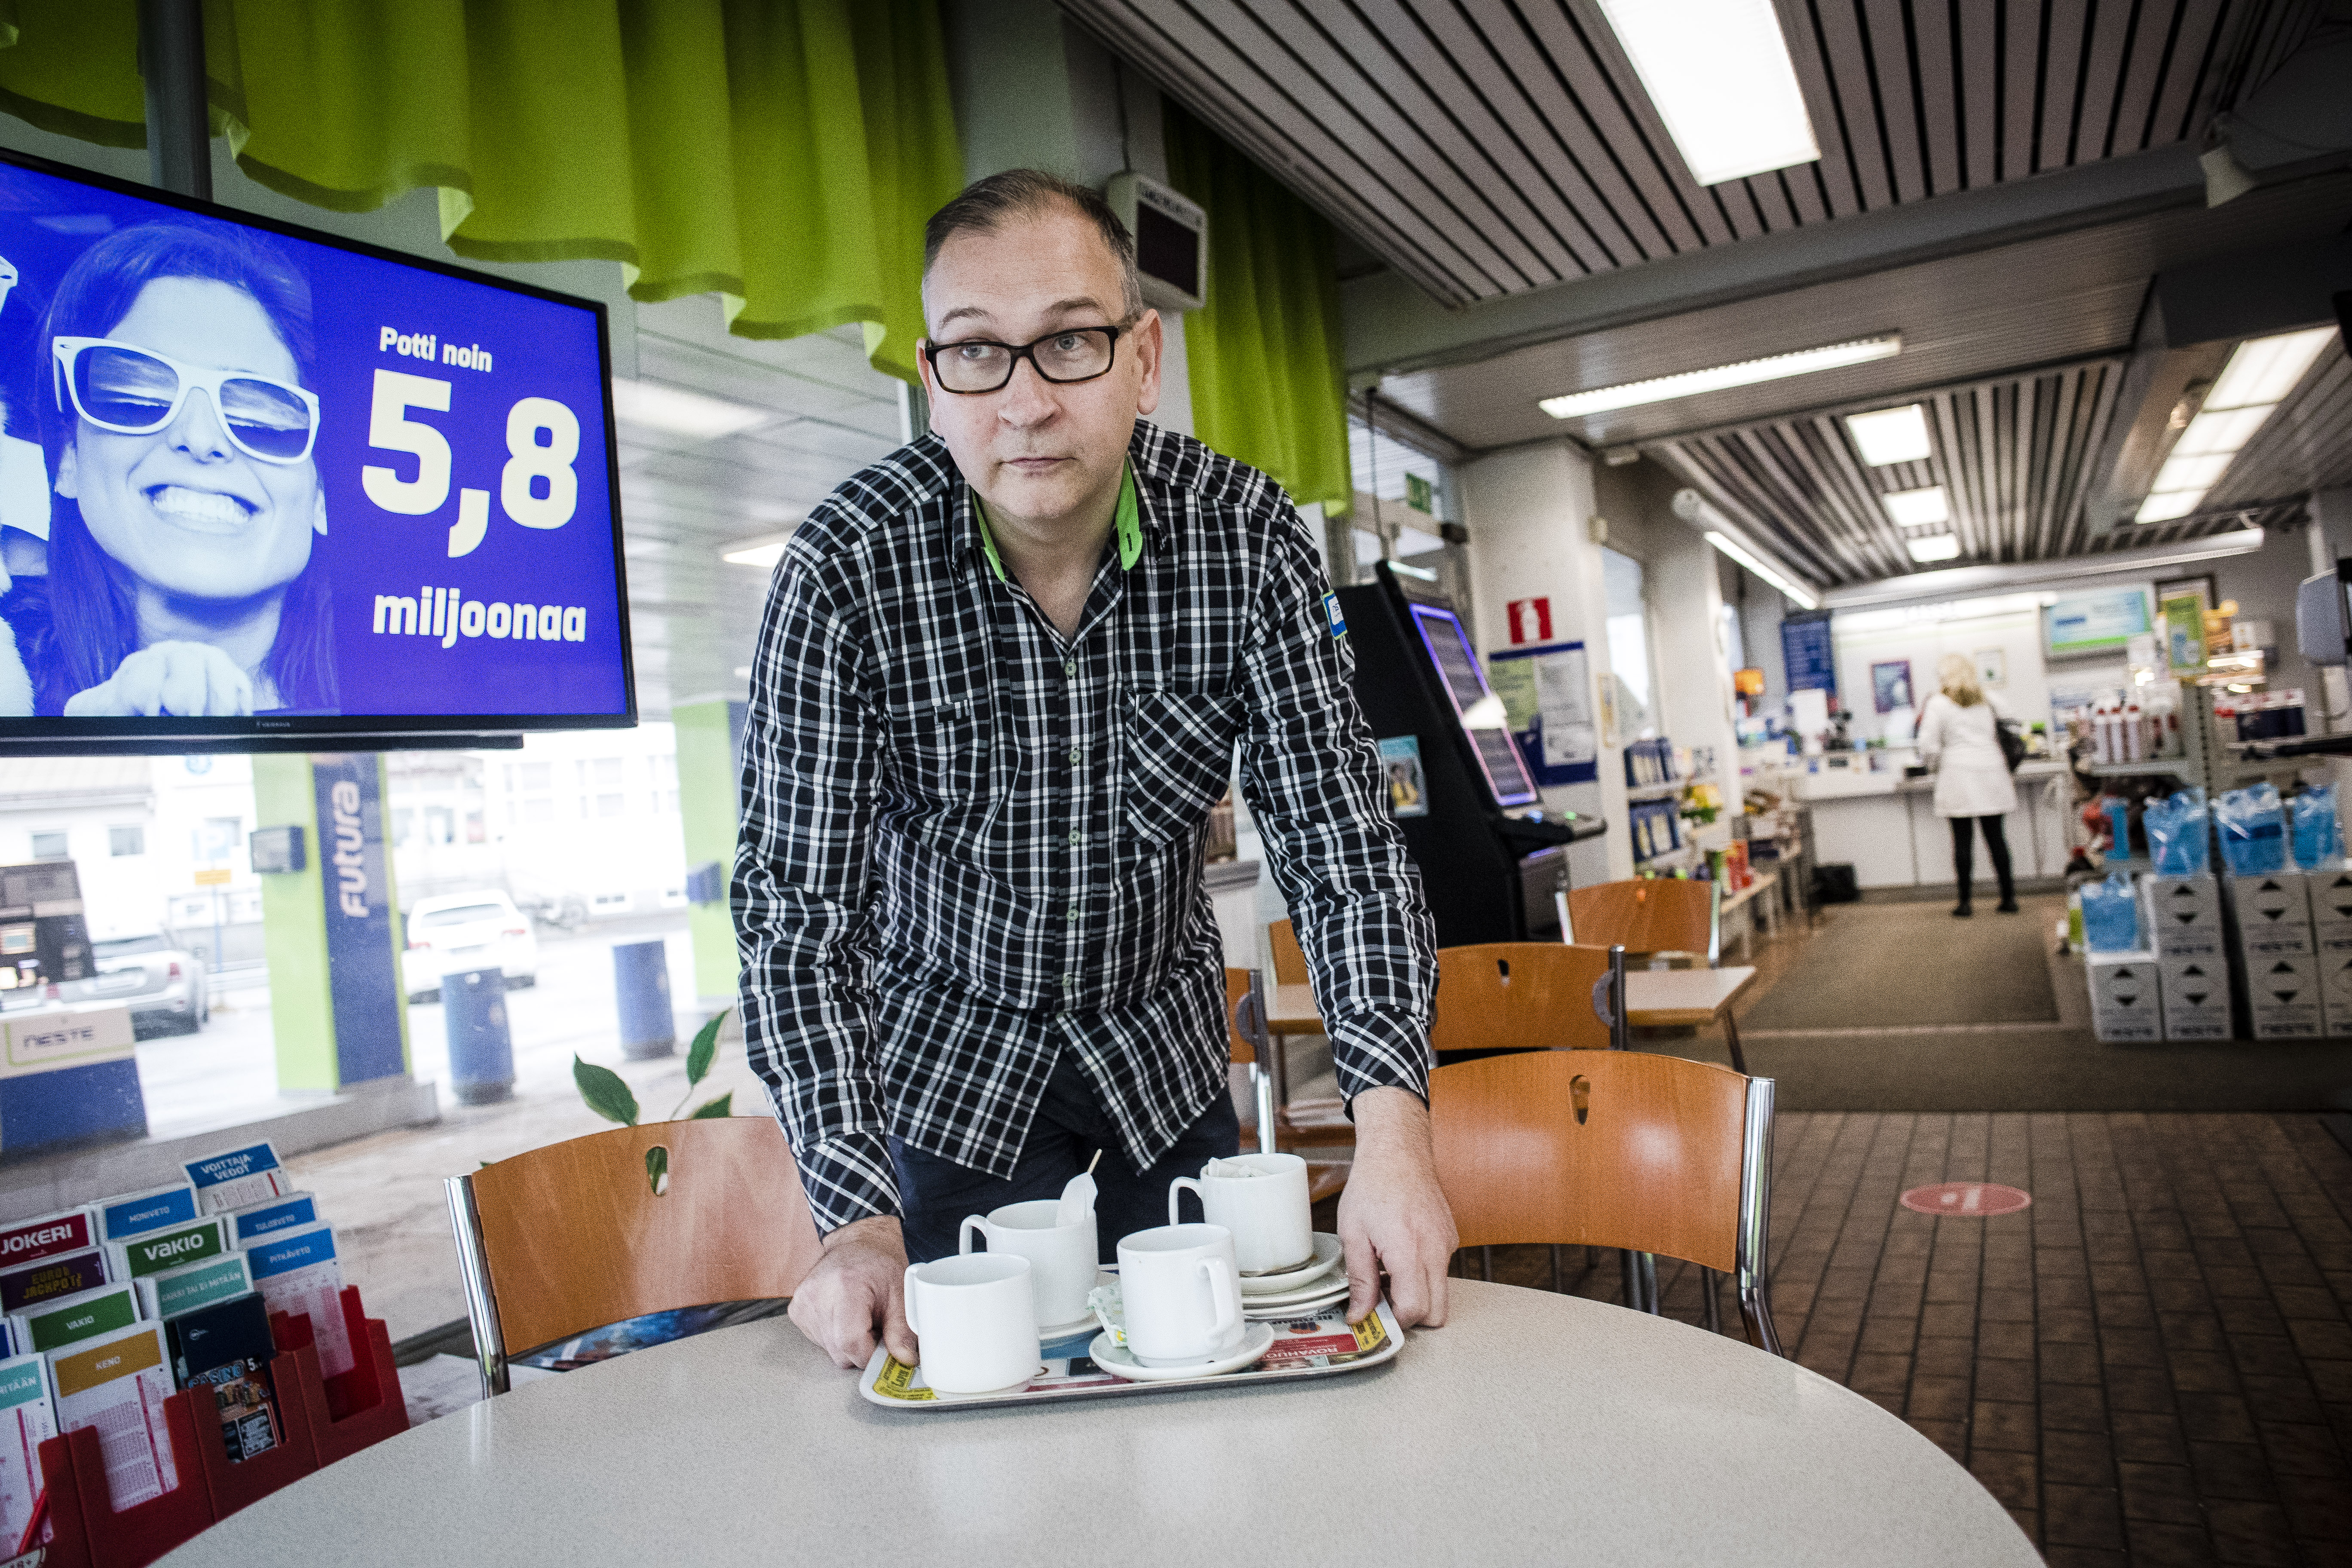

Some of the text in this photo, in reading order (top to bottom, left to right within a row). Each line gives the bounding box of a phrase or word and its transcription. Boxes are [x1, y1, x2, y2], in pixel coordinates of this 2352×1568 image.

[380, 326, 493, 373] Potti noin
[361, 368, 580, 558] 5,8
[373, 585, 586, 649] miljoonaa
[214, 1162, 249, 1181] VEDOT
[129, 1206, 170, 1223] MONIVETO
[0, 1223, 73, 1255] JOKERI
[66, 1315, 95, 1330] VAKIO
[95, 1356, 121, 1371] KENO
